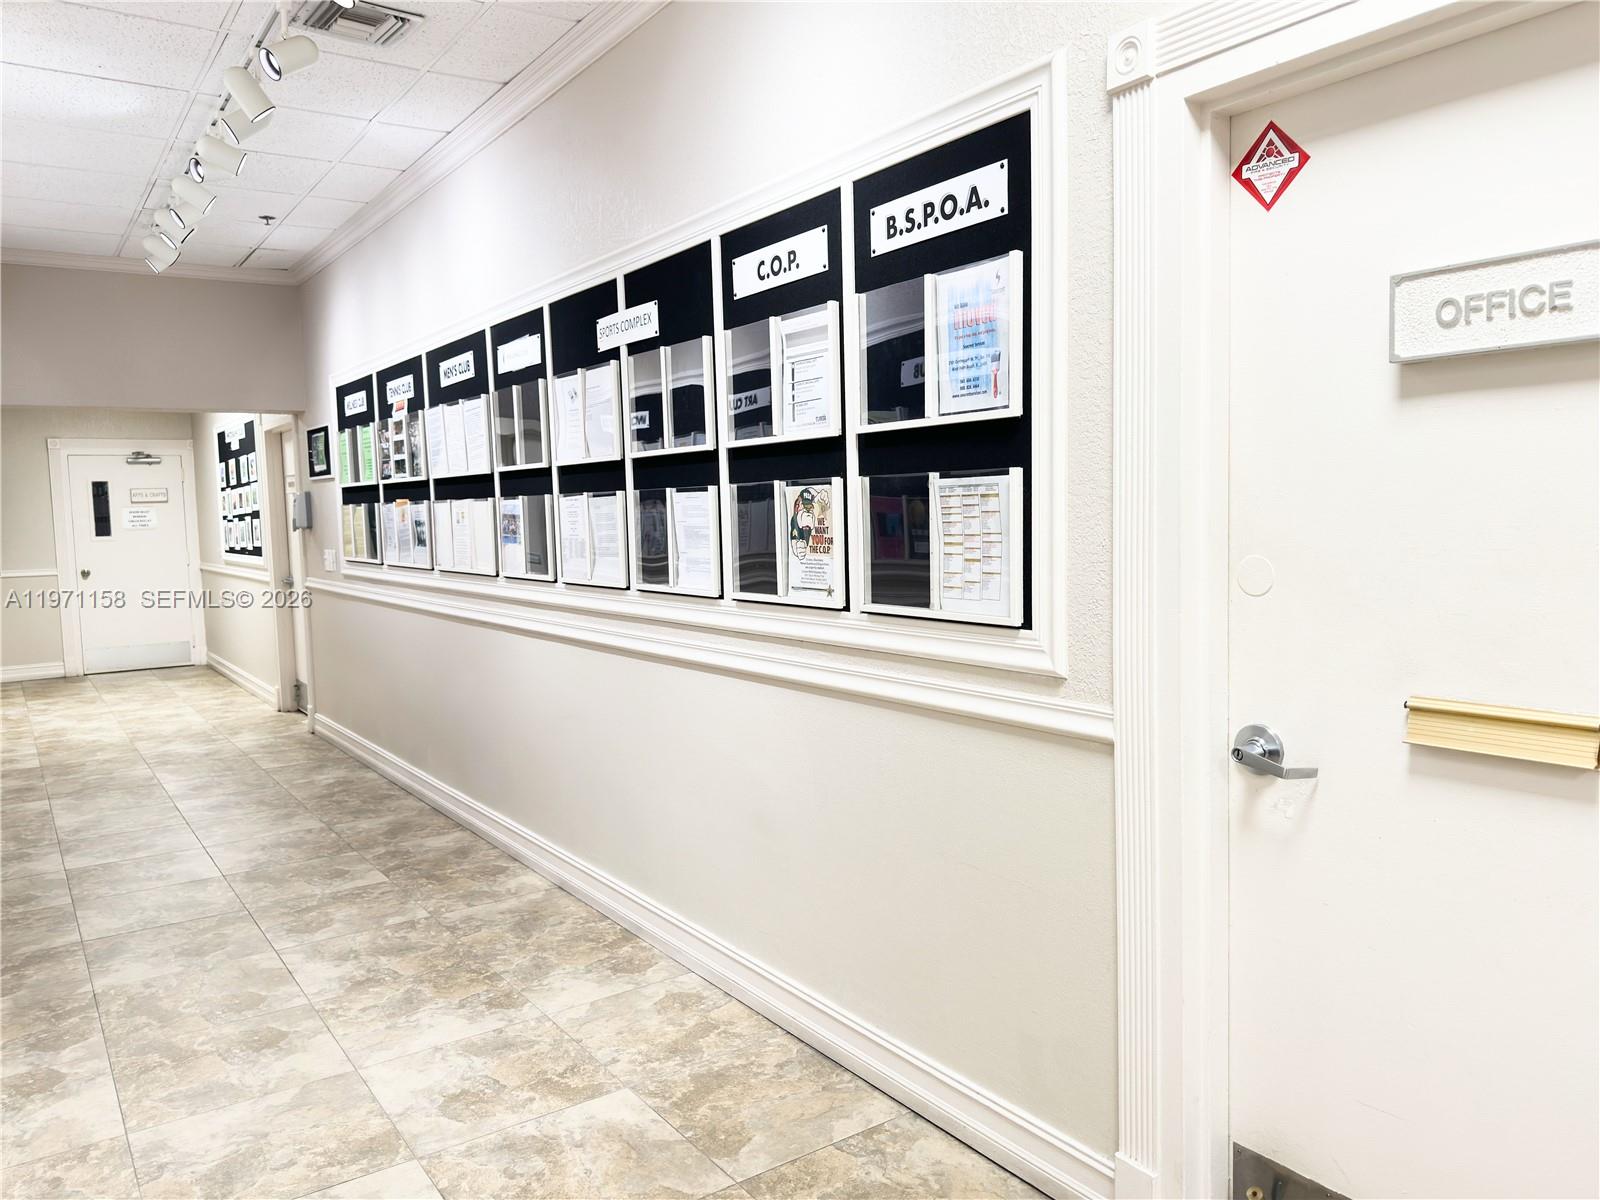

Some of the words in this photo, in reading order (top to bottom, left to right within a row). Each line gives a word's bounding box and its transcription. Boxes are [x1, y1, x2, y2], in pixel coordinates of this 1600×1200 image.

[1245, 156, 1295, 173] ADVANCED
[886, 186, 990, 240] B.S.P.O.A.
[757, 249, 800, 281] C.O.P.
[1435, 279, 1574, 329] OFFICE
[599, 322, 620, 340] SPORTS
[620, 312, 652, 333] COMPLEX
[443, 364, 458, 380] MEN'S
[458, 360, 470, 374] CLUB
[401, 381, 412, 394] CLUB
[817, 517, 826, 526] WE
[811, 534, 824, 545] YOU
[815, 526, 829, 536] WANT
[809, 545, 819, 554] THE
